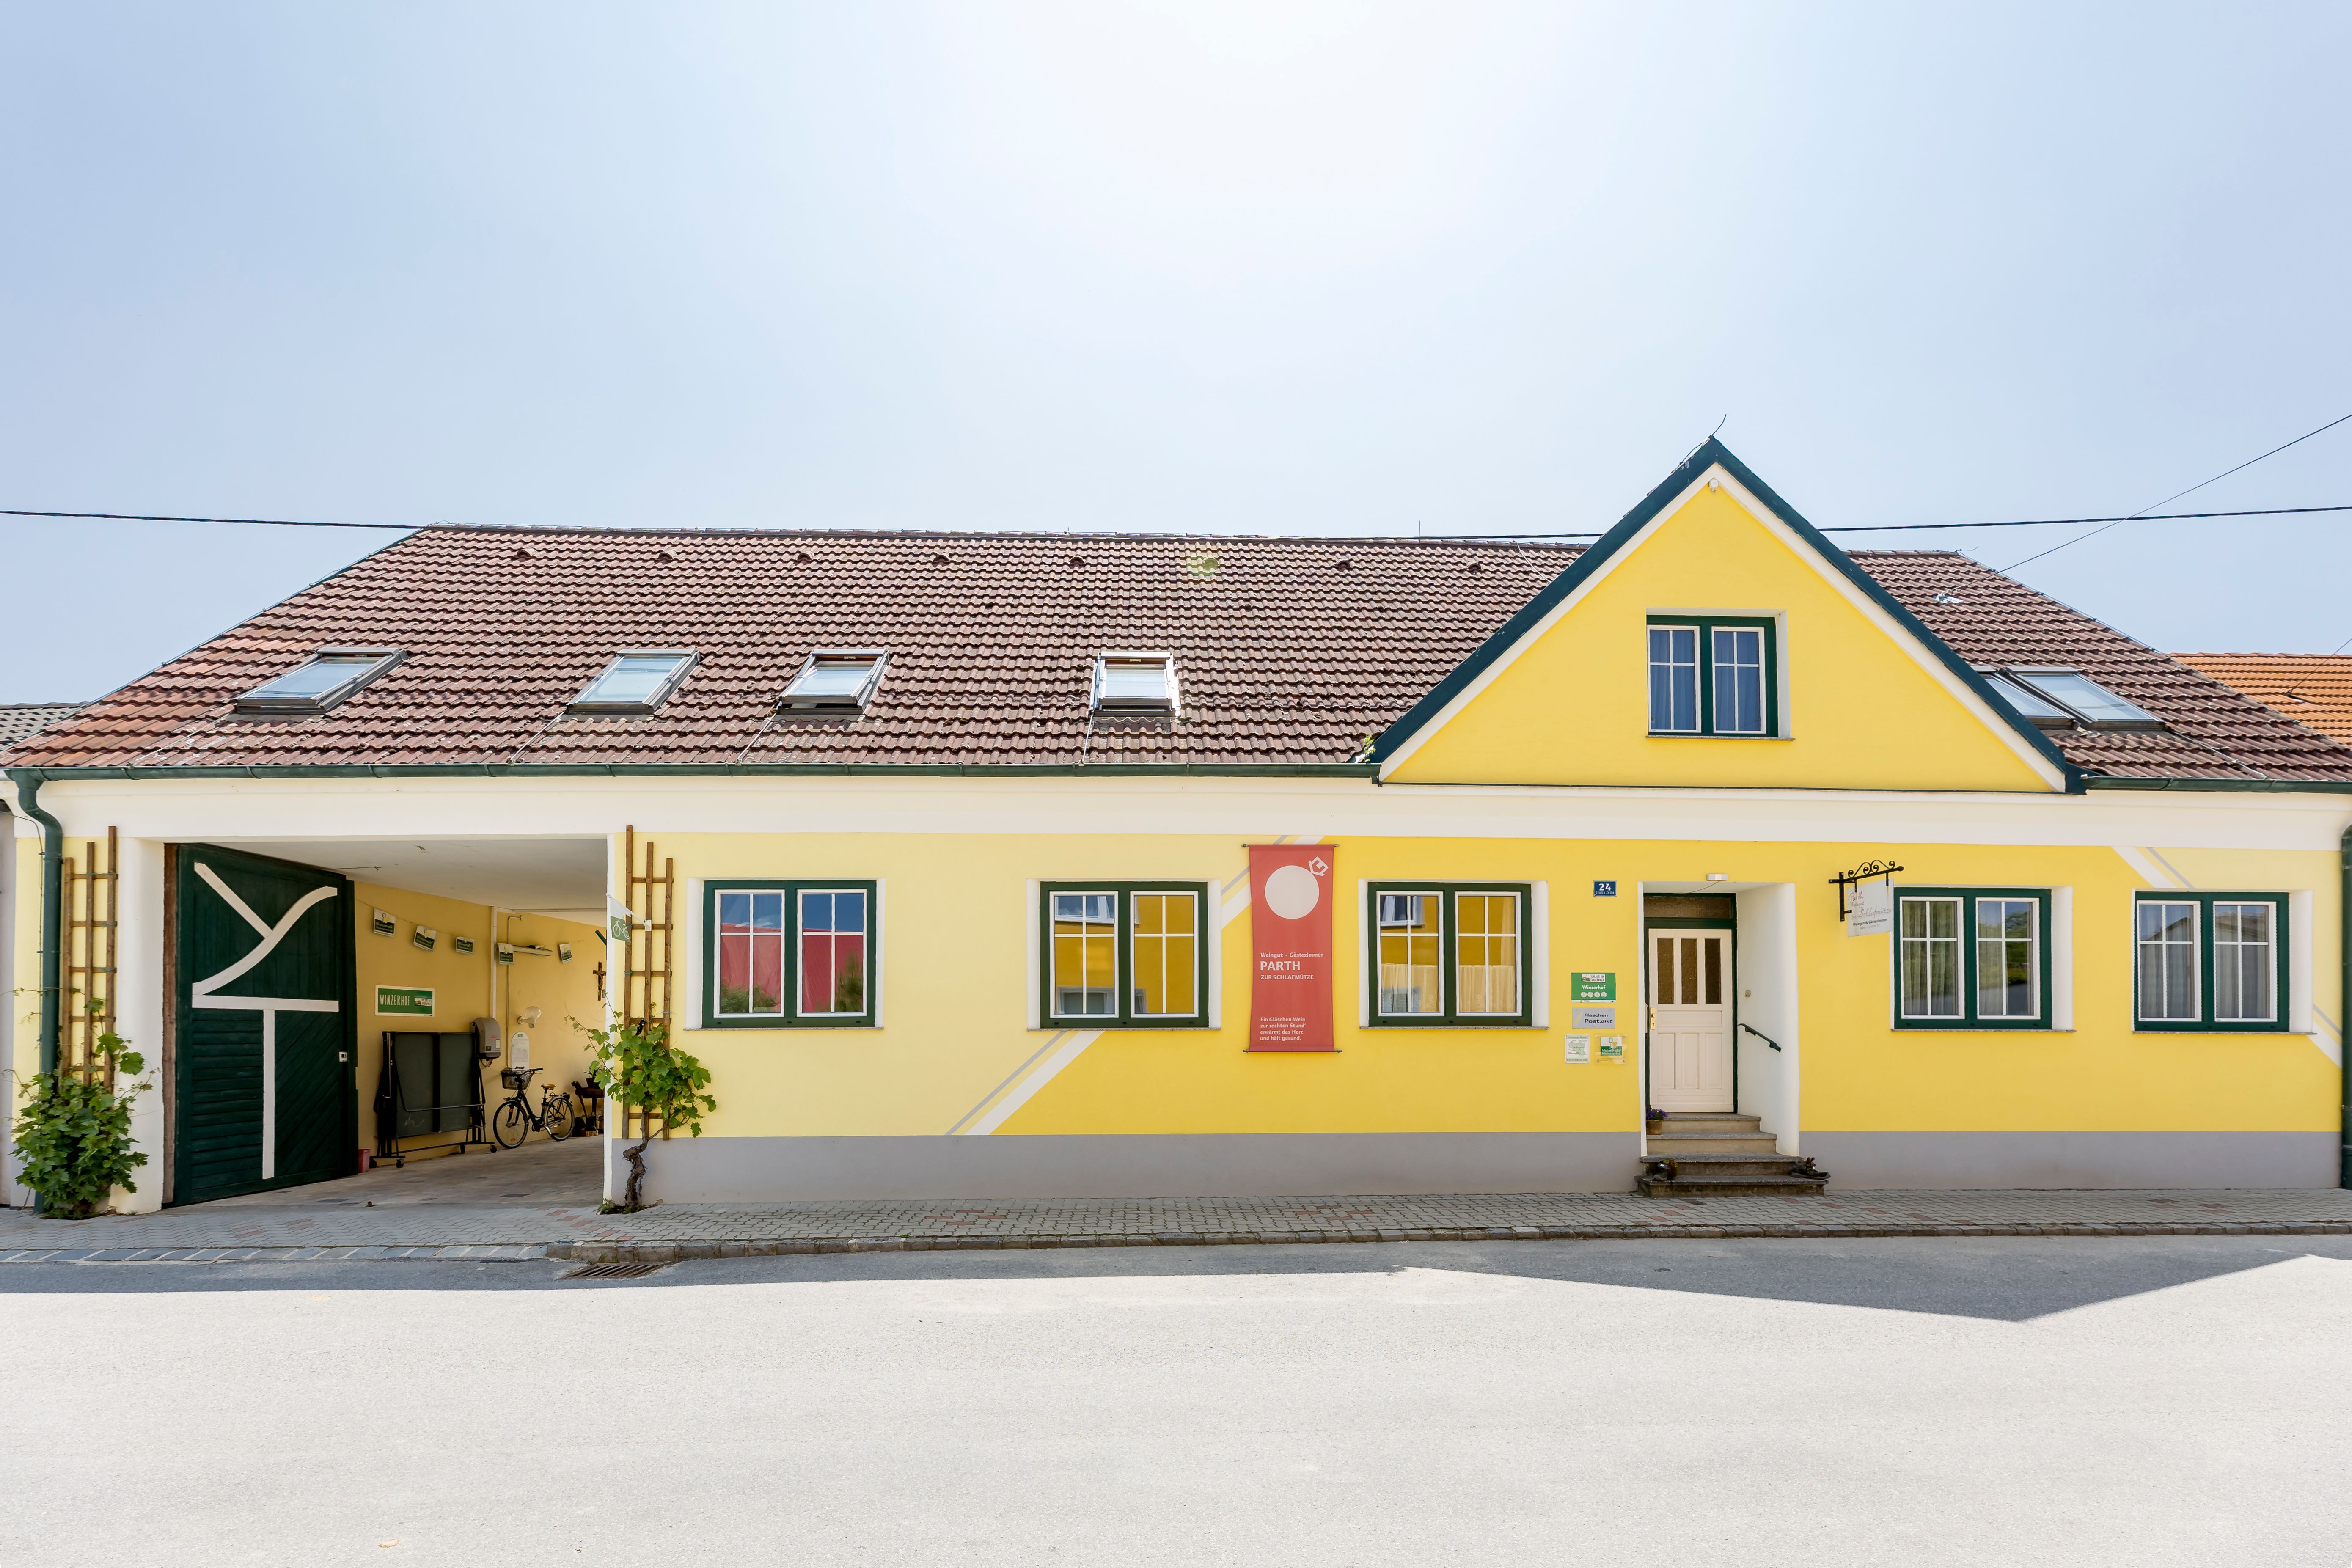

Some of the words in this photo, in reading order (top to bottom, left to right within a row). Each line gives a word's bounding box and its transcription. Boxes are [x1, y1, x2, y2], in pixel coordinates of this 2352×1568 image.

[1848, 891, 1864, 901] Parth
[1260, 961, 1300, 971] PARTH
[380, 994, 410, 1006] WINZERHOF
